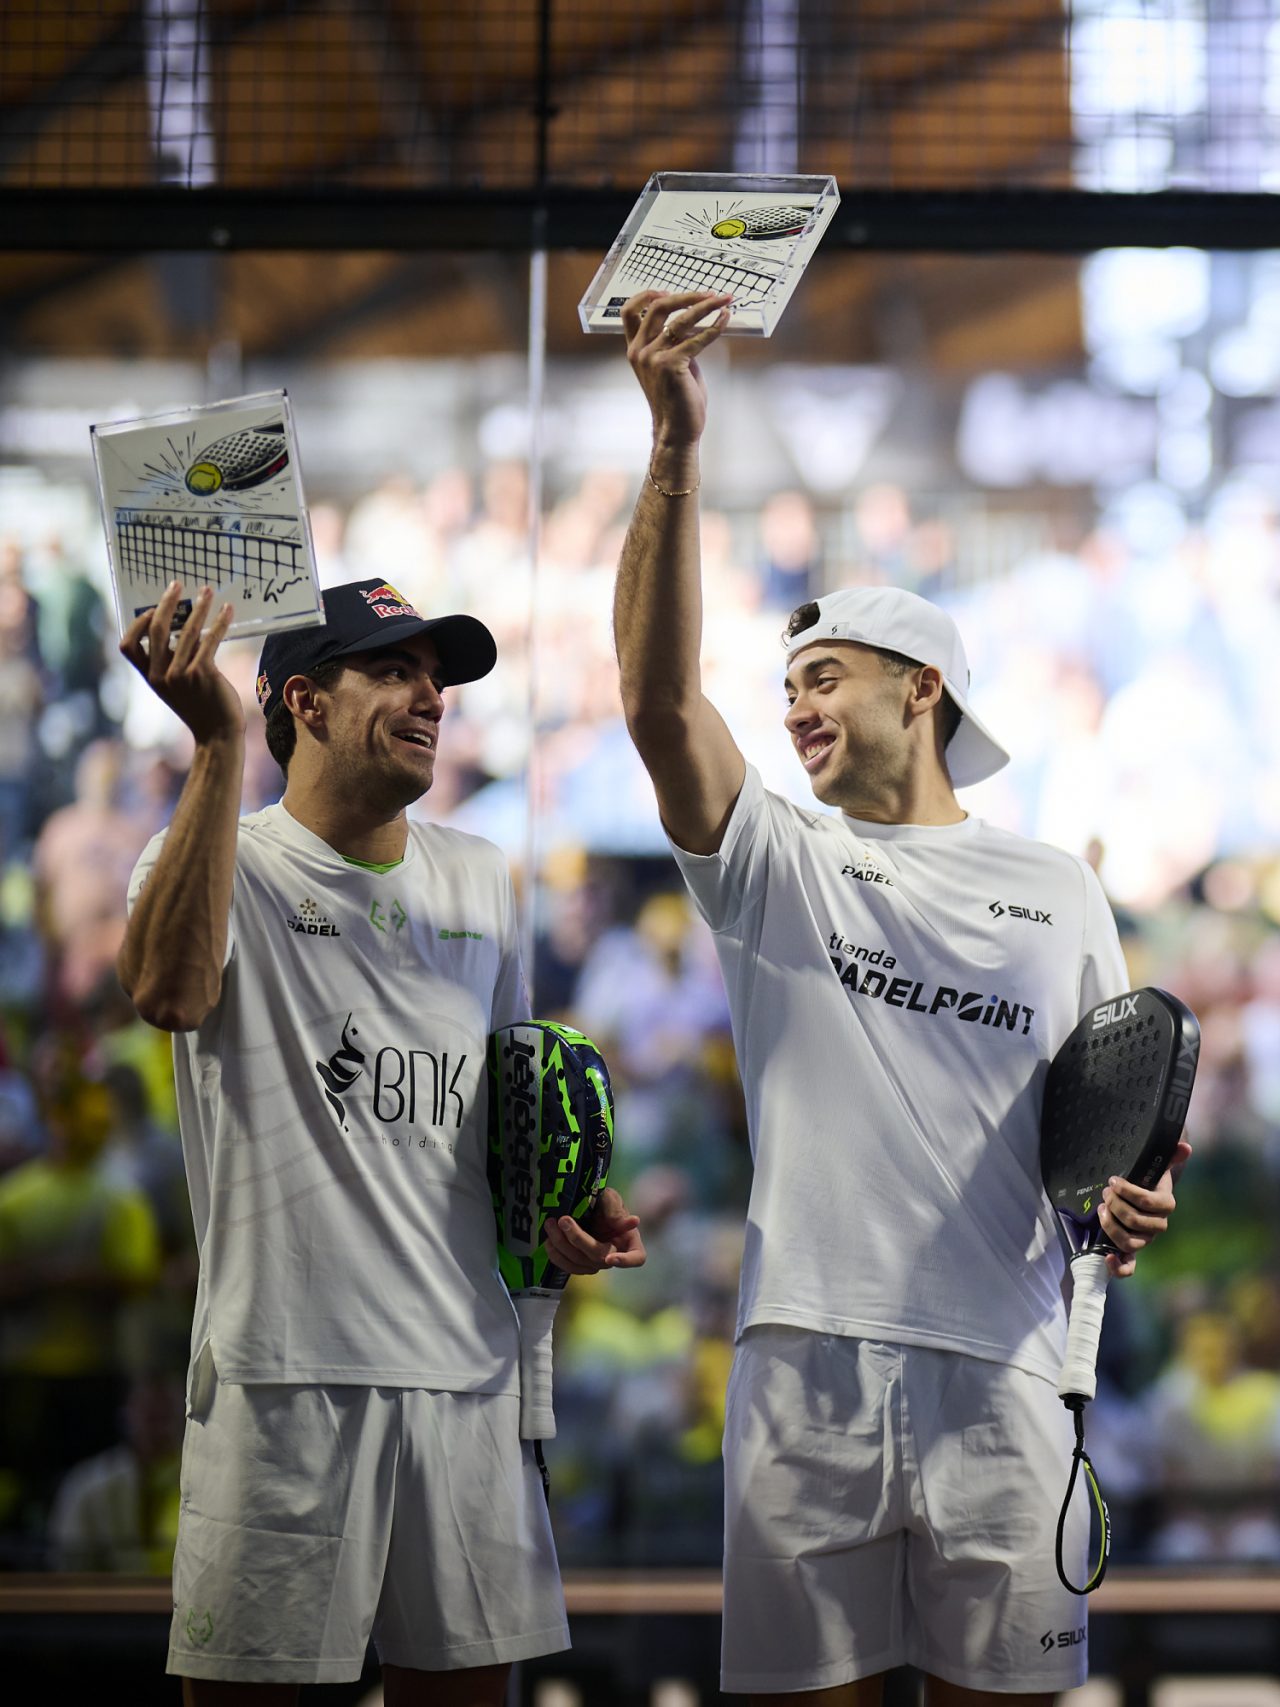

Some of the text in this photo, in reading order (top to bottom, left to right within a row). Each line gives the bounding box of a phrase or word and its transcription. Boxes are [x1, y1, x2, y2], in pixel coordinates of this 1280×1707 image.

[841, 864, 894, 887] PADEL
[1008, 905, 1053, 926] SIUX
[287, 919, 341, 937] PADEL
[828, 932, 898, 970] tienda
[1091, 994, 1140, 1031] SIUX
[382, 1134, 453, 1153] holdig
[1057, 1625, 1087, 1648] SIUX
